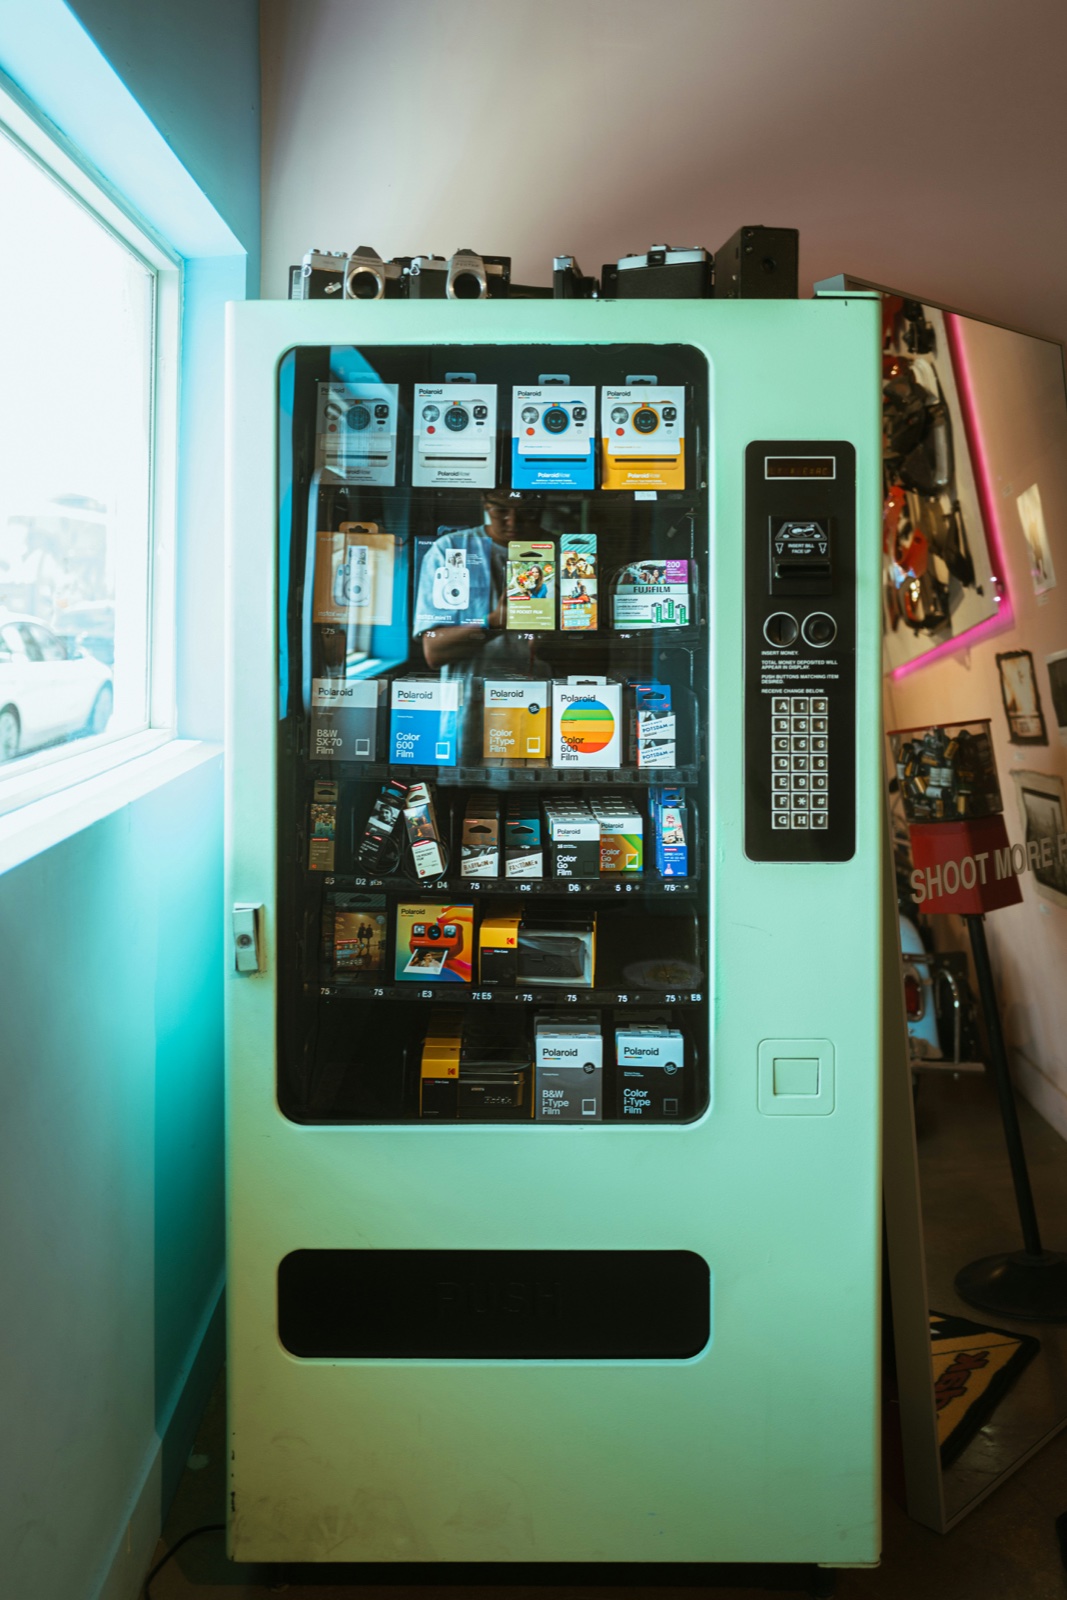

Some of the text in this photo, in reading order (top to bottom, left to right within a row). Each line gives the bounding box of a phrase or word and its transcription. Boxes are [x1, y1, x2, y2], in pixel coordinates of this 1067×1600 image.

[318, 687, 353, 697] Polaroid
[398, 690, 433, 700] Polaroid
[490, 690, 524, 698] Polaroid
[560, 694, 596, 702] Polaroid
[779, 701, 825, 710] A 1 2
[780, 720, 788, 729] B
[316, 729, 338, 738] B&W
[396, 732, 421, 741] Color
[489, 729, 513, 737] Color
[316, 738, 343, 746] SX-70
[560, 736, 585, 744] Color
[779, 740, 787, 748] C
[799, 740, 806, 748] 5
[396, 741, 414, 750] 600
[489, 745, 507, 753] Film
[560, 745, 578, 753] 600
[315, 747, 334, 755] Film
[396, 750, 415, 758] Film
[560, 753, 579, 761] Film
[779, 758, 825, 767] D 7 8
[779, 777, 787, 786] E
[798, 778, 806, 786] 9
[780, 796, 787, 805] F
[778, 815, 824, 824] G H J
[910, 852, 989, 904] SHOOT
[994, 837, 1053, 880] MORE
[437, 881, 448, 889] D4
[470, 882, 480, 890] 75
[568, 884, 580, 892] D6
[401, 908, 425, 916] Polaroid
[374, 988, 384, 996] 75
[481, 992, 492, 1000] E5
[523, 994, 533, 1002] 75
[567, 994, 577, 1002] 75
[542, 1048, 578, 1057] Polaroid
[623, 1047, 659, 1056] Polaroid
[542, 1089, 564, 1098] B&W
[623, 1088, 648, 1097] Color
[542, 1107, 561, 1115] Film
[623, 1106, 643, 1114] Film
